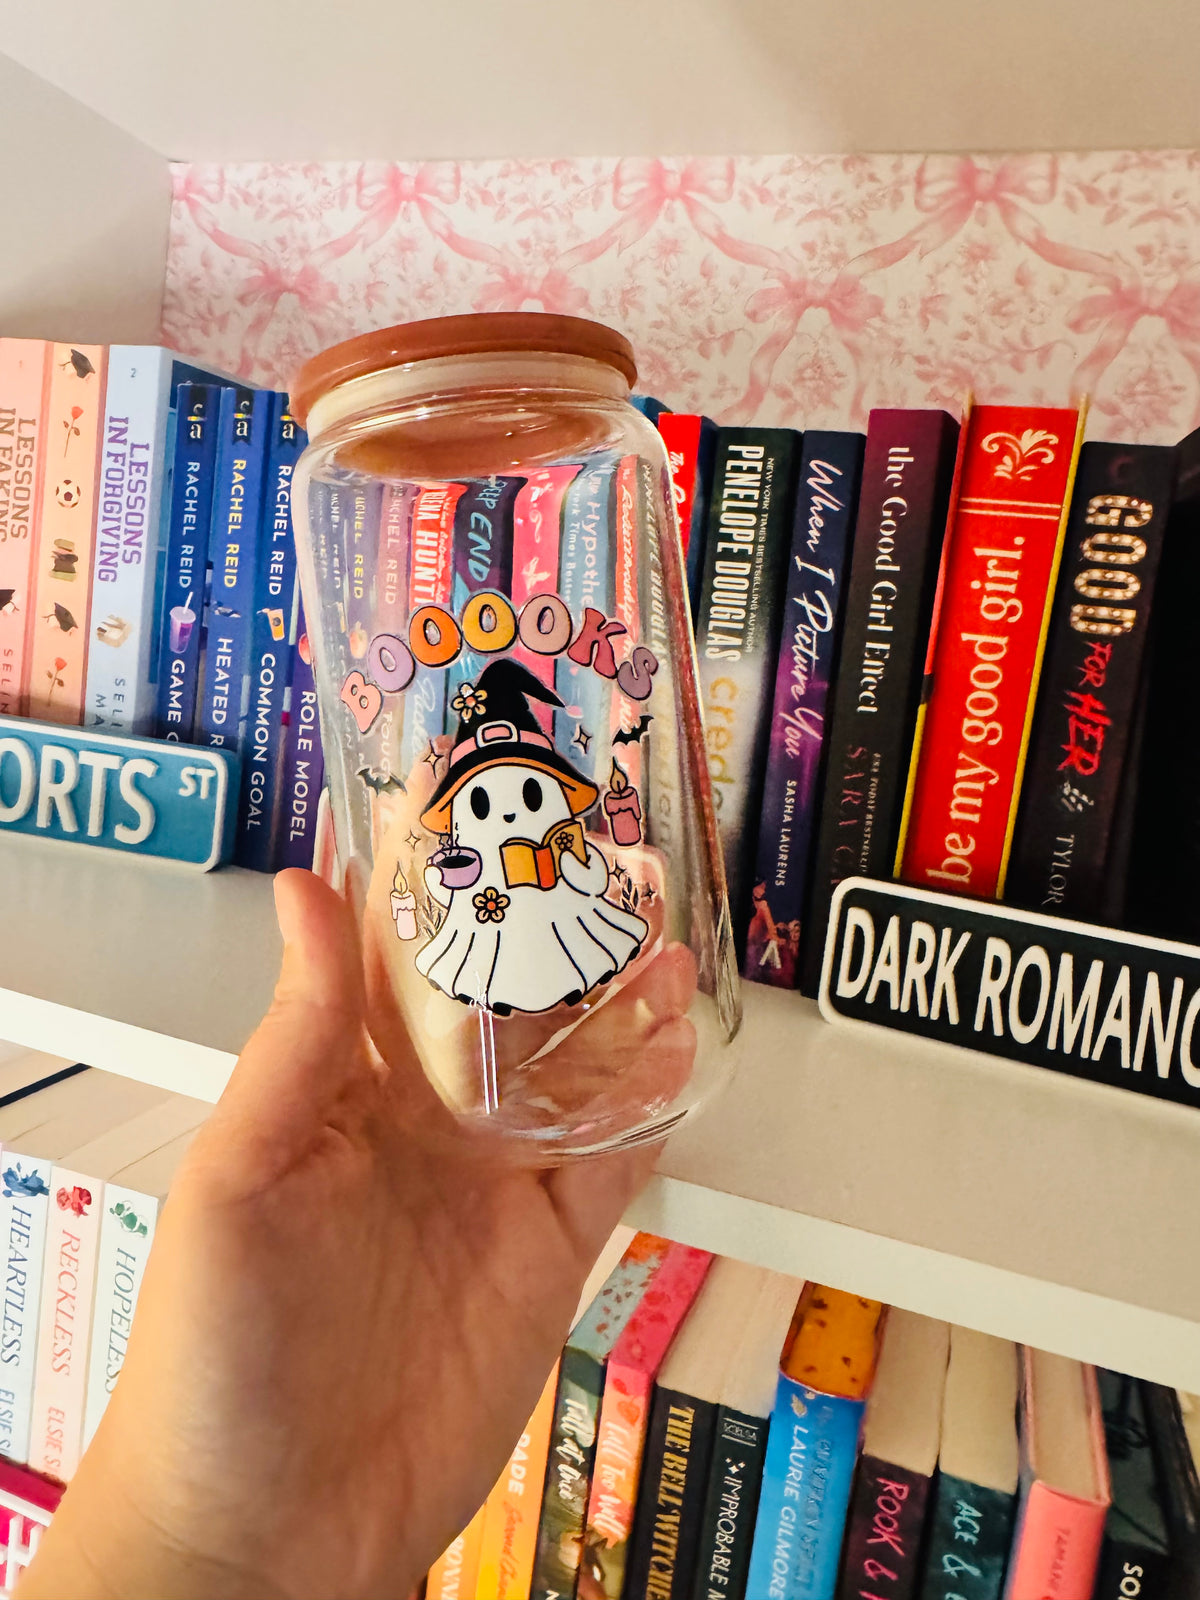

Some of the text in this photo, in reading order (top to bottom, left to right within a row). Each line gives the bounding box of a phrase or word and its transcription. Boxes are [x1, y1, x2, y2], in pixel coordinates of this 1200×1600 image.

[0, 408, 17, 444] IN
[129, 367, 138, 379] 2
[11, 418, 37, 540] LESSONS
[98, 416, 129, 584] IN FORGIVING
[122, 442, 151, 566] LESSONS
[178, 461, 201, 589] RACHEL REID
[223, 458, 247, 588] RACHEL REID
[268, 464, 293, 596] RACHEL REID
[875, 496, 908, 572] Good
[353, 553, 365, 600] REID
[384, 559, 398, 605] REID
[467, 513, 492, 581] END
[704, 445, 765, 663] PENELOPE DOUGLAS
[745, 457, 776, 653] NEW YORK TIMES BESTSELLING AUTHOR
[778, 458, 846, 760] When I Picture You
[867, 580, 898, 632] Girl
[1056, 494, 1154, 777] GOOD FOR HER
[166, 659, 186, 724] GAME
[213, 637, 234, 725] HEATED
[341, 592, 659, 733] BOOOOKS
[856, 641, 891, 713] Effect
[926, 536, 1026, 885] be my good girl.
[0, 737, 216, 845] ORTS ST
[246, 653, 276, 831] COMMON GOAL
[289, 690, 318, 843] ROLE MODEL
[774, 779, 798, 887] SASHA LAURENS
[1041, 833, 1076, 907] TYLOR
[836, 906, 1200, 1090] DARK ROMANC
[0, 1204, 32, 1369] HEARTLESS
[51, 1228, 81, 1377] RECKLESS
[105, 1247, 136, 1395] HOPELESS
[0, 1388, 15, 1435] ELSIE
[45, 1405, 65, 1453] ELSIE
[664, 1405, 696, 1452] THE
[657, 1451, 689, 1507] BELL
[708, 1475, 743, 1585] IMPROBABLE
[768, 1424, 809, 1600] LAURIE GILMORE
[866, 1477, 910, 1558] ROOK
[952, 1500, 983, 1545] ACE
